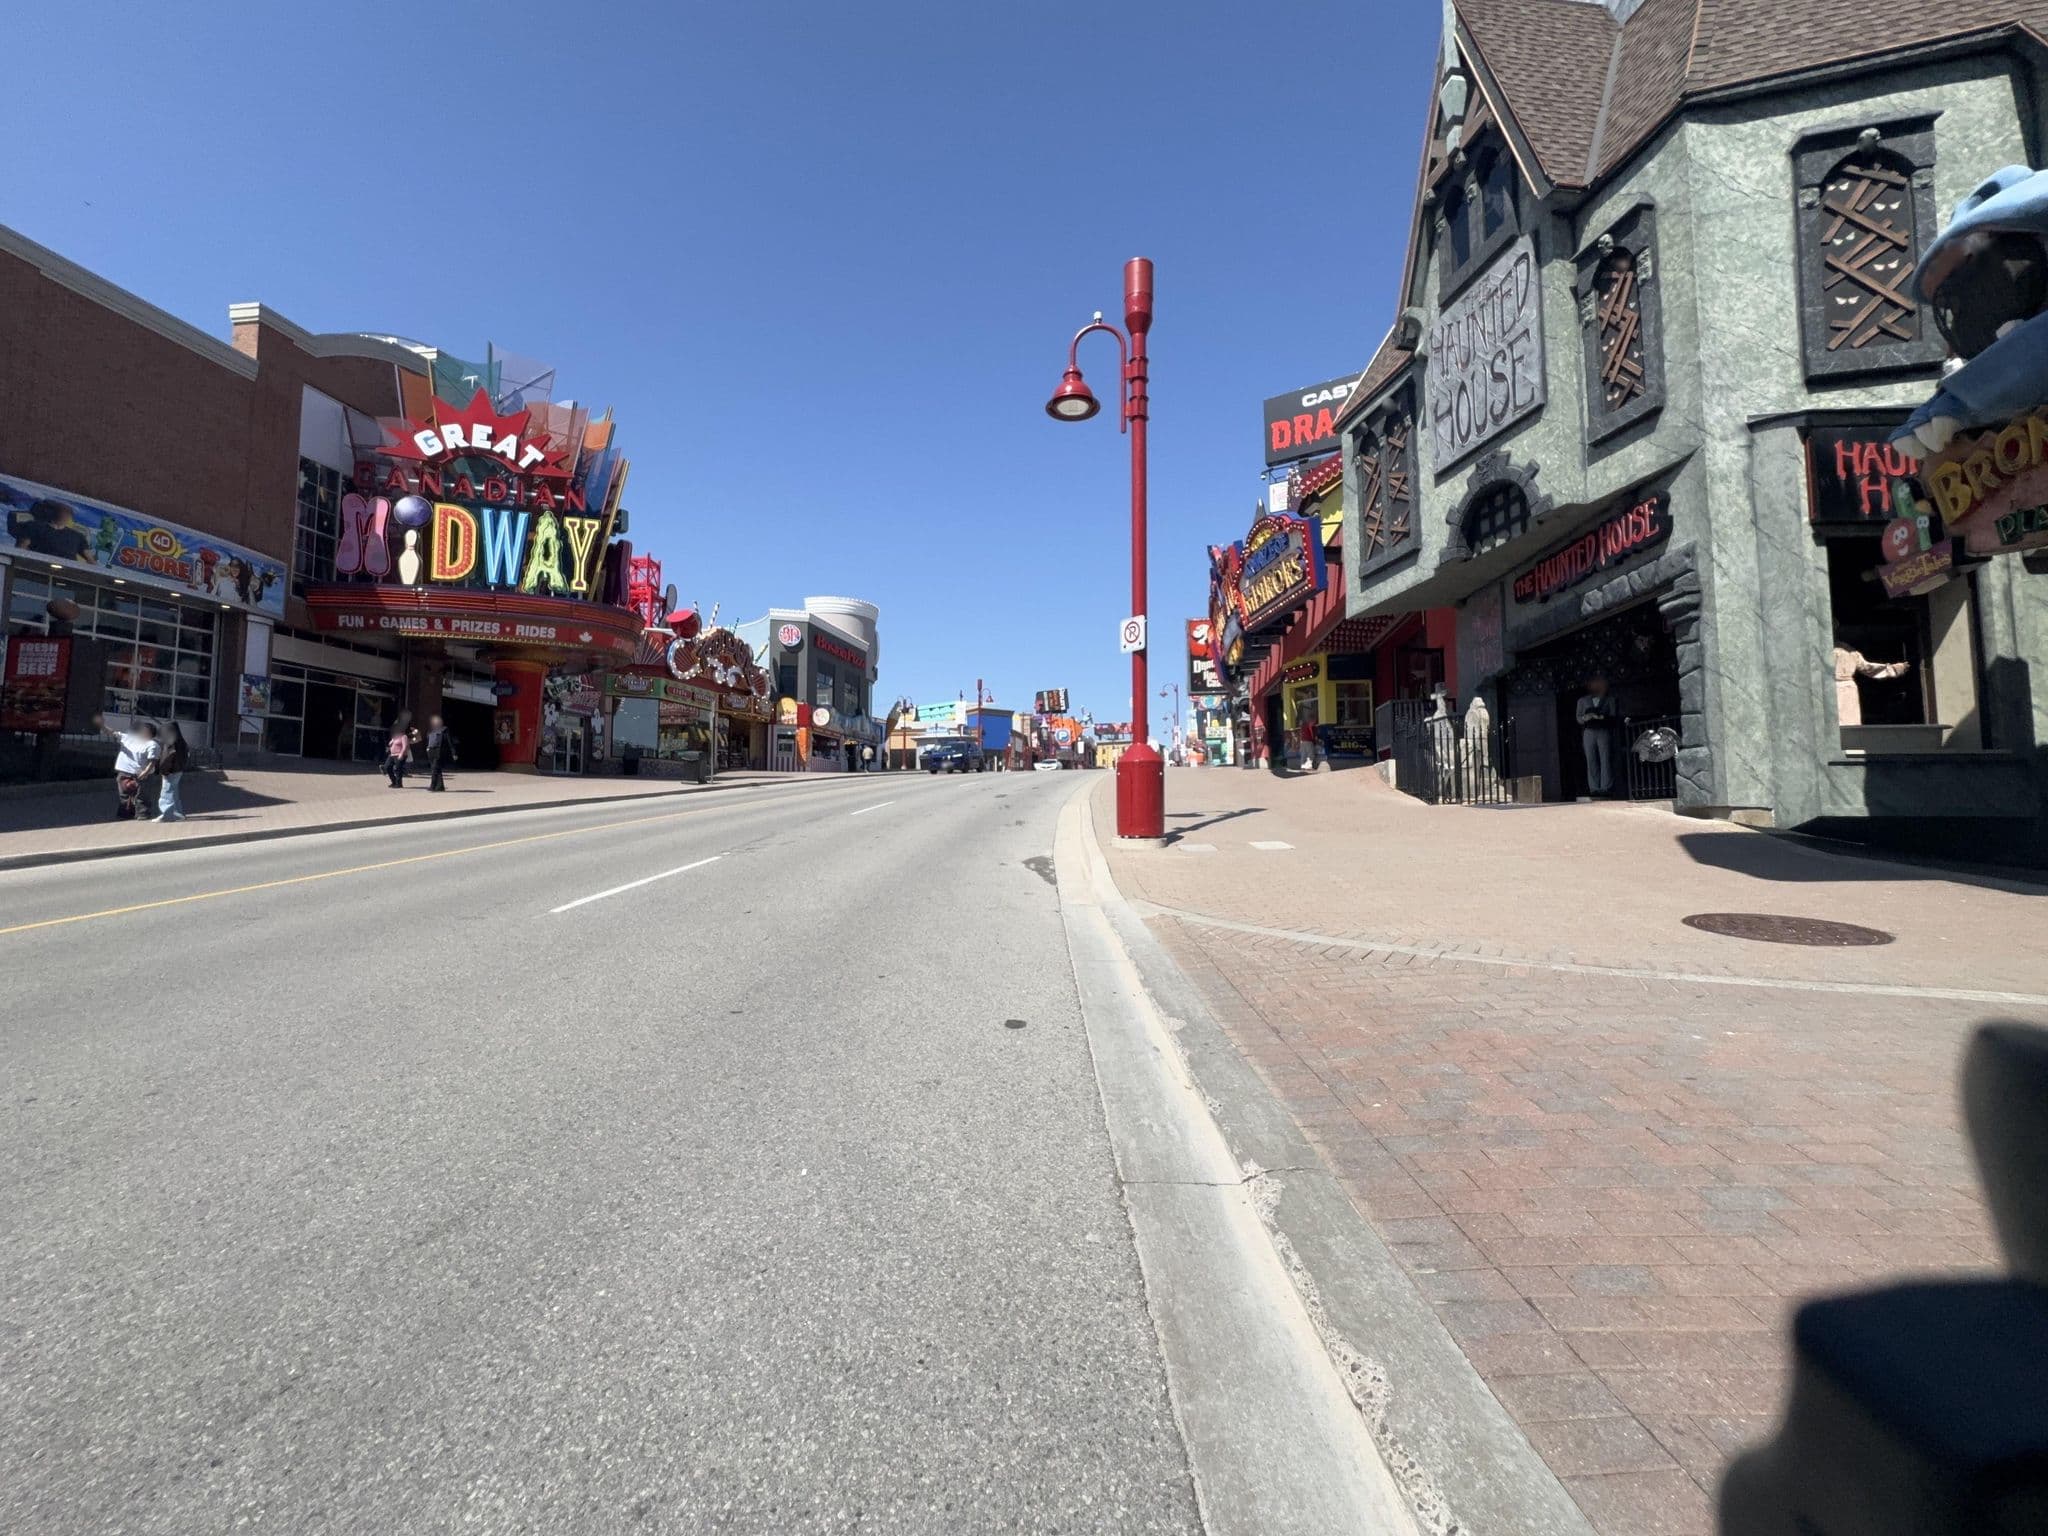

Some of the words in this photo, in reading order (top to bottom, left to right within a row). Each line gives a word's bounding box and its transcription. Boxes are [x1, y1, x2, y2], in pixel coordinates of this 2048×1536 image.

[1430, 252, 1530, 380] HAUNTED
[1434, 327, 1535, 456] HOUSE
[414, 423, 545, 468] GREAT
[1271, 404, 1344, 452] DRA
[354, 461, 587, 511] CANADIAN
[119, 546, 193, 581] STORE
[1515, 575, 1534, 598] THE
[1535, 534, 1596, 594] HAUNTED
[1599, 497, 1660, 565] HOUSE
[339, 615, 364, 628] FUN
[380, 616, 428, 630] GAMES
[434, 618, 444, 630] &
[452, 619, 500, 635] PRIZES
[515, 624, 556, 638] RIDES
[17, 663, 56, 675] BEEF
